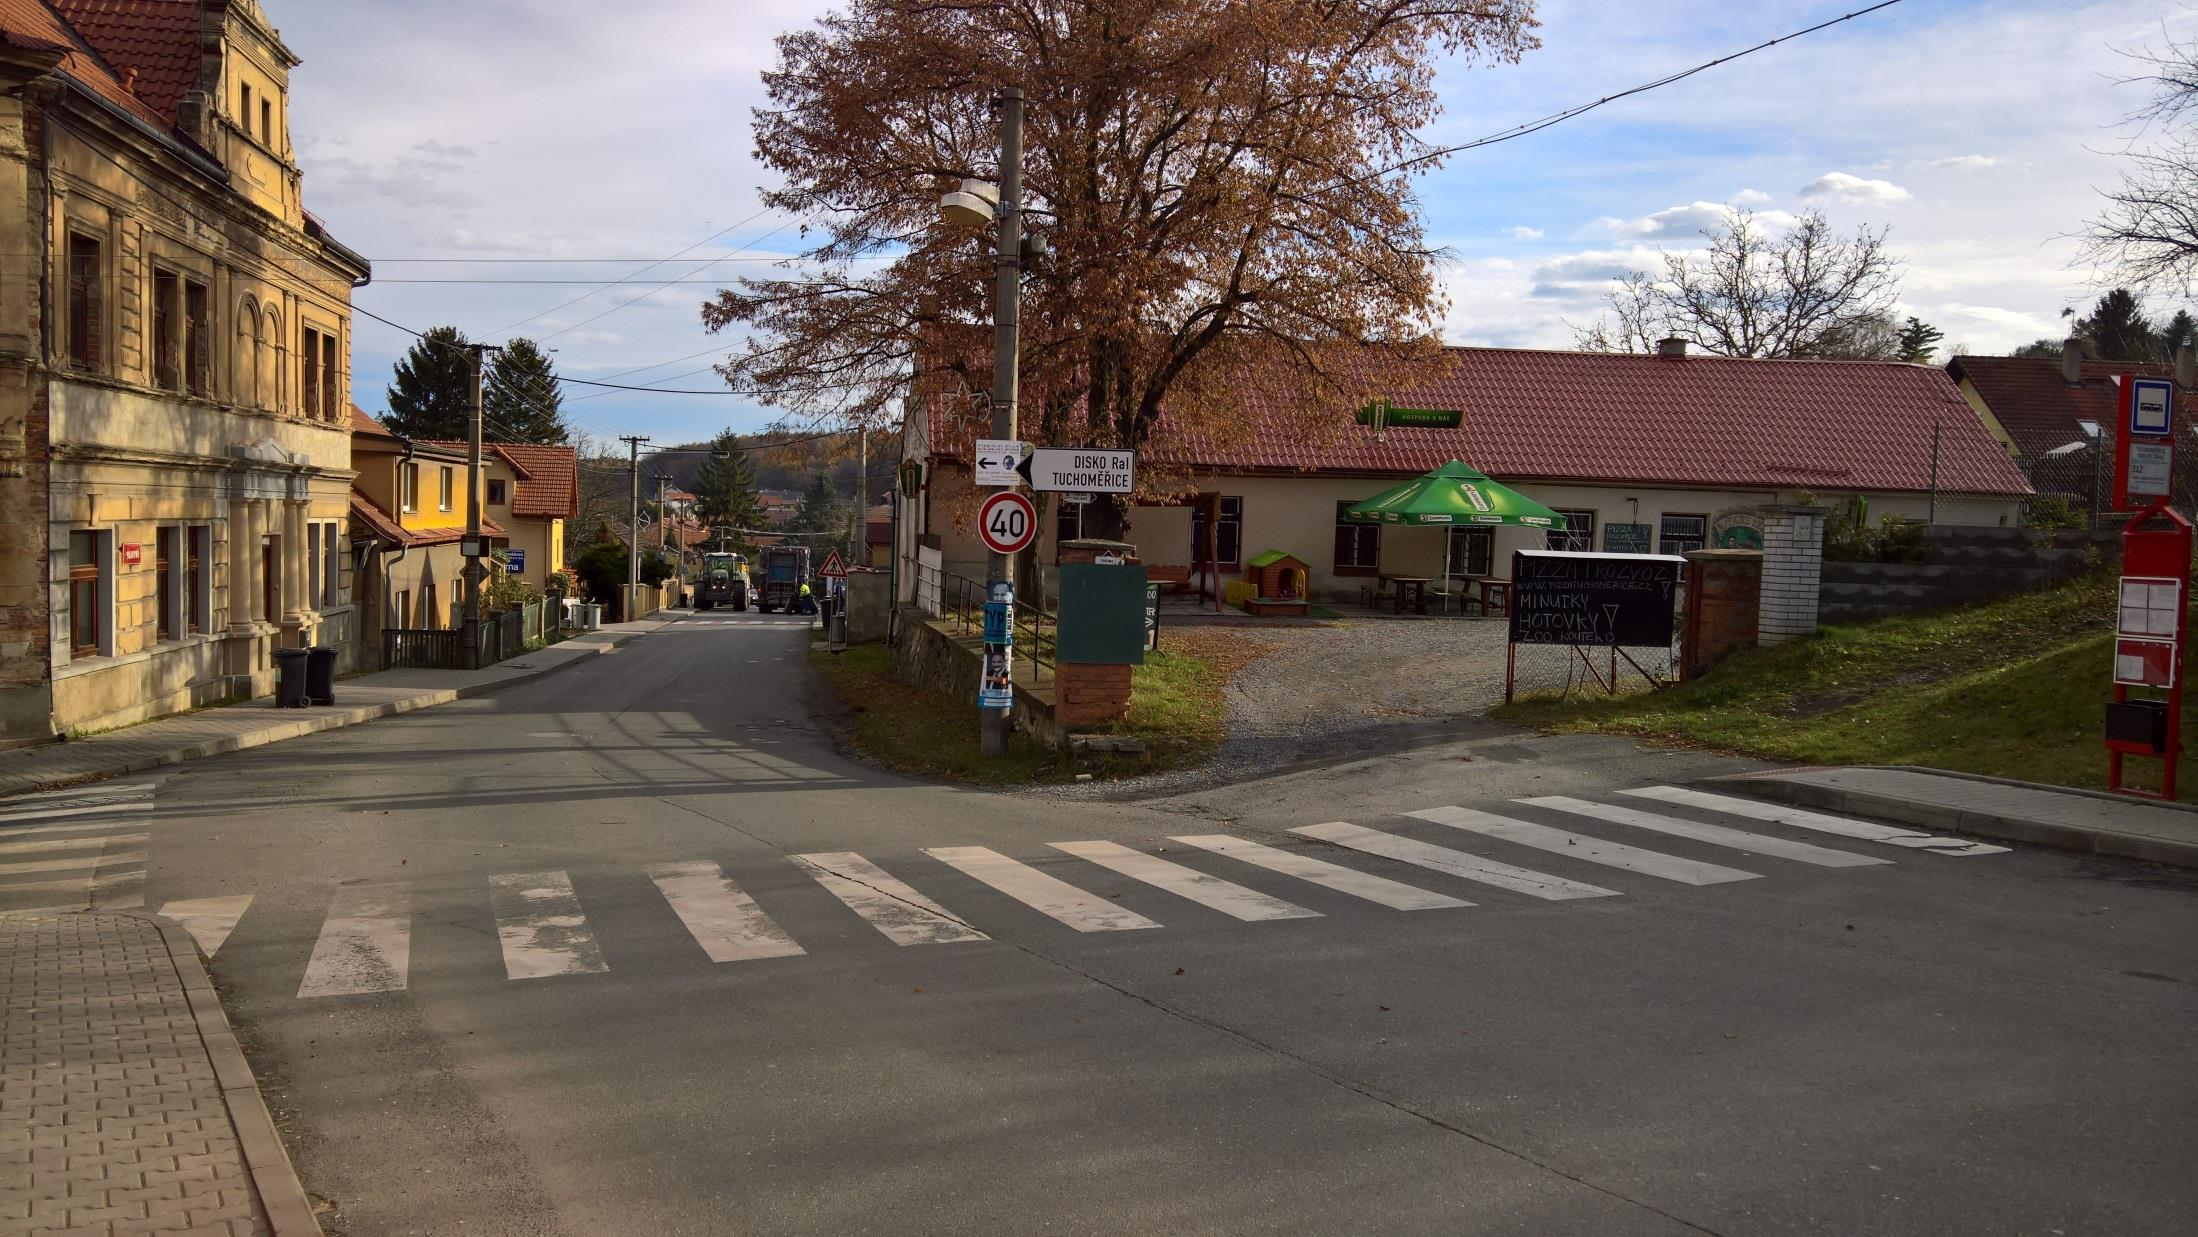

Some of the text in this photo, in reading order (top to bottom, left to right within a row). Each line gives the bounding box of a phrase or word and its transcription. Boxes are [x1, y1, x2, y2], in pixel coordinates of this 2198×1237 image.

[1074, 455, 1106, 469] DISKO
[1052, 470, 1129, 487] TUCHOMĚŘICE
[990, 509, 1024, 538] 40
[1517, 558, 1577, 579] PIZZA
[1594, 562, 1669, 581] ROZVOZ
[1520, 593, 1589, 611] MINUTKY
[1519, 611, 1598, 632] HOTOVKY
[1523, 630, 1553, 642] ZOO
